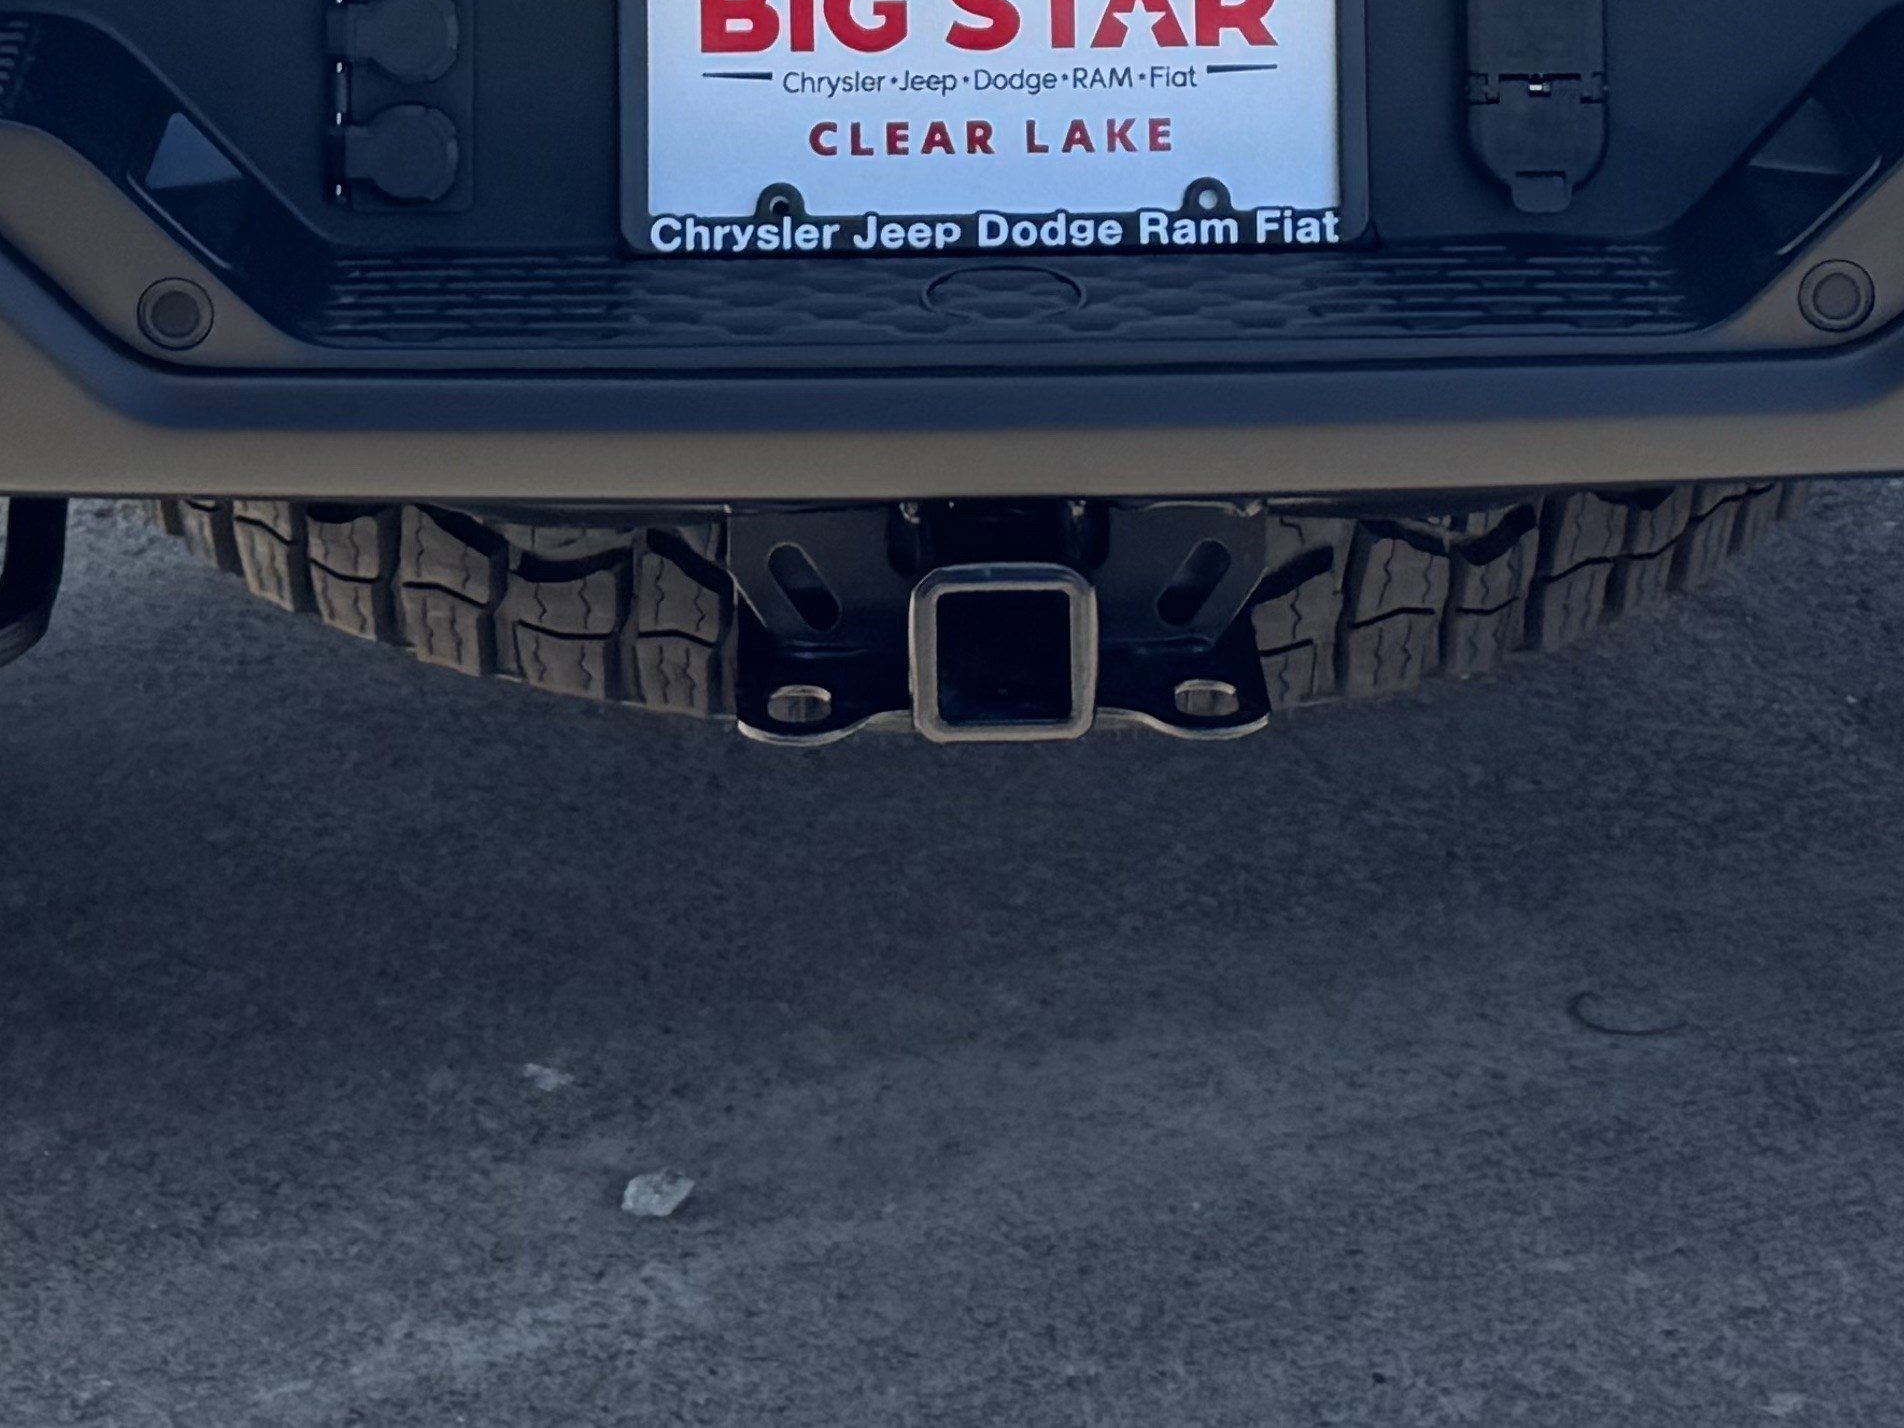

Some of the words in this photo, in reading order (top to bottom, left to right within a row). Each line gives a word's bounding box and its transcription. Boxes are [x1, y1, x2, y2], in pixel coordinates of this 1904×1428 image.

[782, 70, 886, 99] Chrysler
[898, 69, 958, 98] Jeep
[973, 68, 1058, 96] Dodge
[1072, 66, 1134, 90] RAM
[1149, 65, 1198, 89] Fiat
[809, 120, 995, 157] CLEAR
[1026, 117, 1173, 154] LAKE
[649, 214, 840, 253] Chrysler
[853, 214, 962, 250] Jeep
[977, 211, 1124, 248] Dodge
[1139, 209, 1239, 245] Ram
[1255, 207, 1341, 244] Fiat
